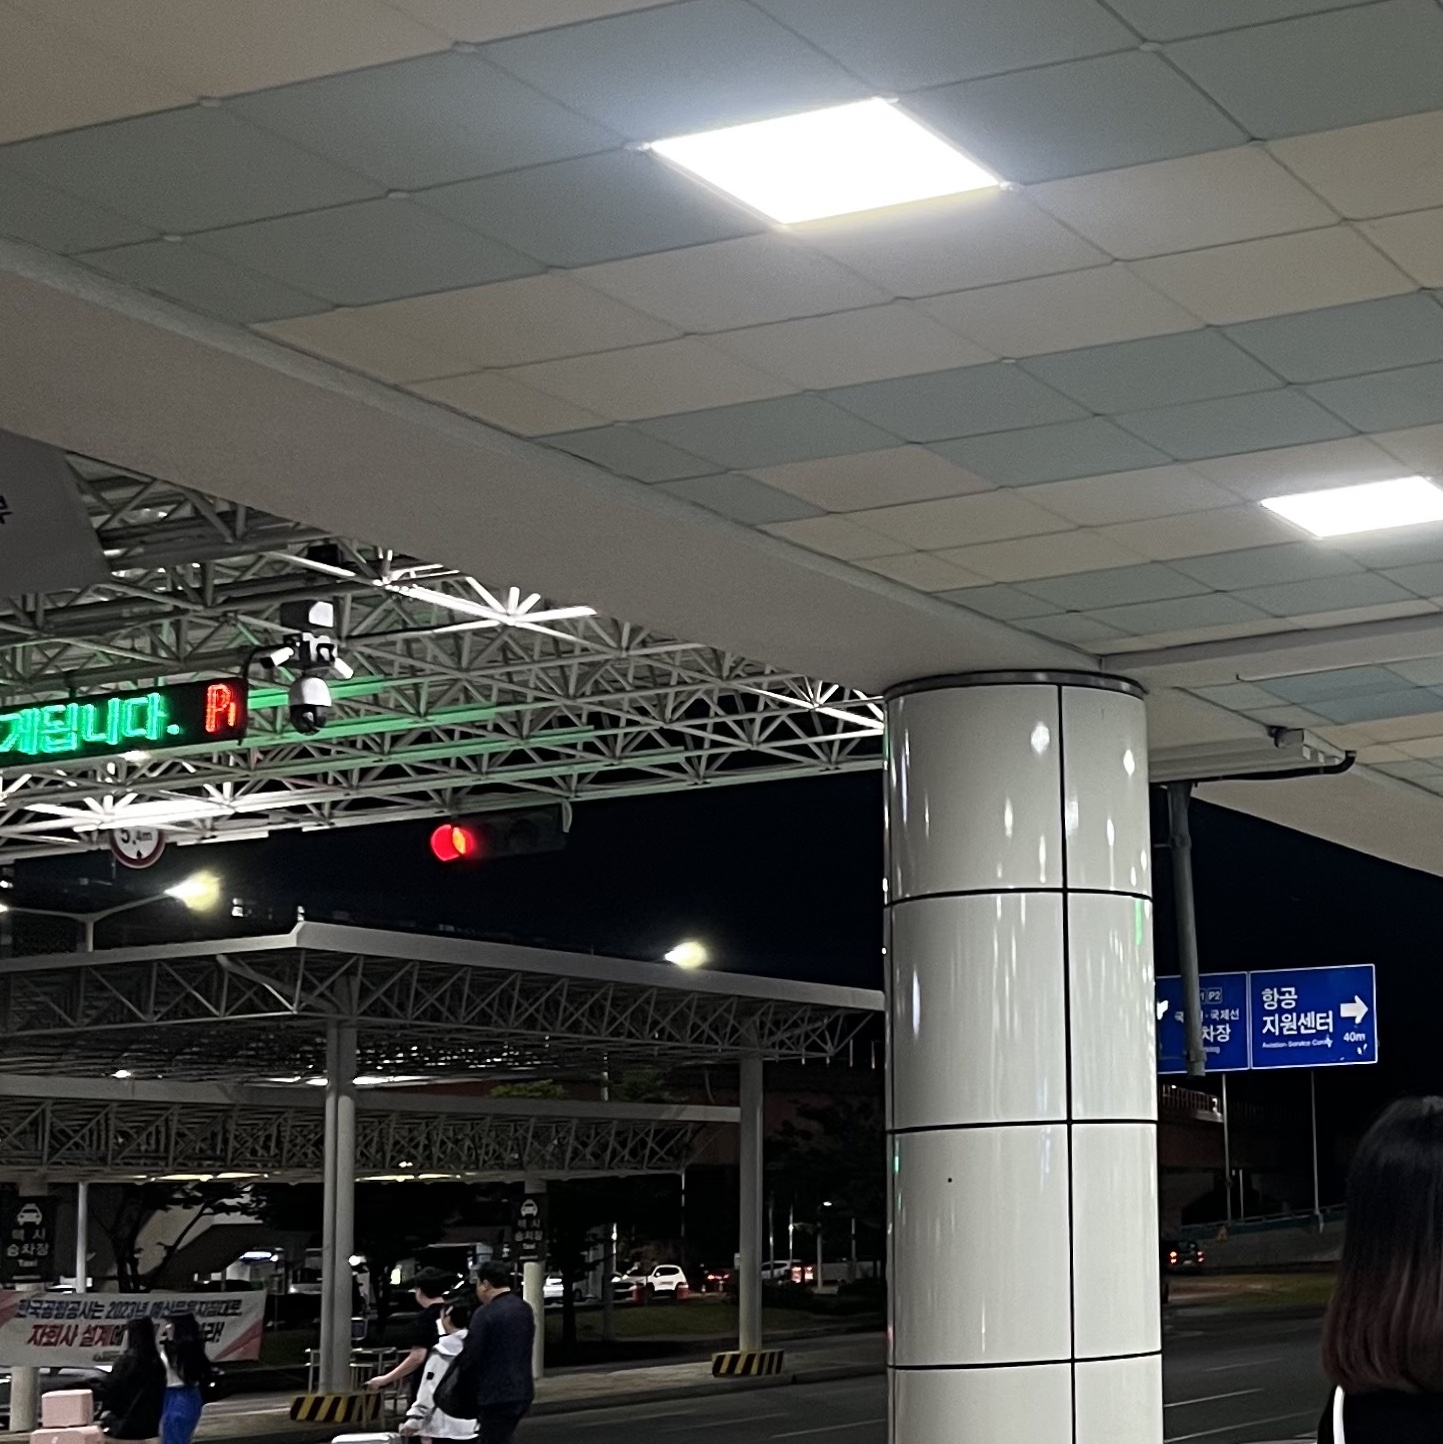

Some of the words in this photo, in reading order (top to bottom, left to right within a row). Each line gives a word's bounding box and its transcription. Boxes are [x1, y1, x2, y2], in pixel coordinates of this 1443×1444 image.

[1208, 991, 1221, 1001] P2
[1261, 987, 1298, 1010] 항공
[1262, 1011, 1334, 1036] 지원센터
[1343, 1032, 1366, 1042] 40m
